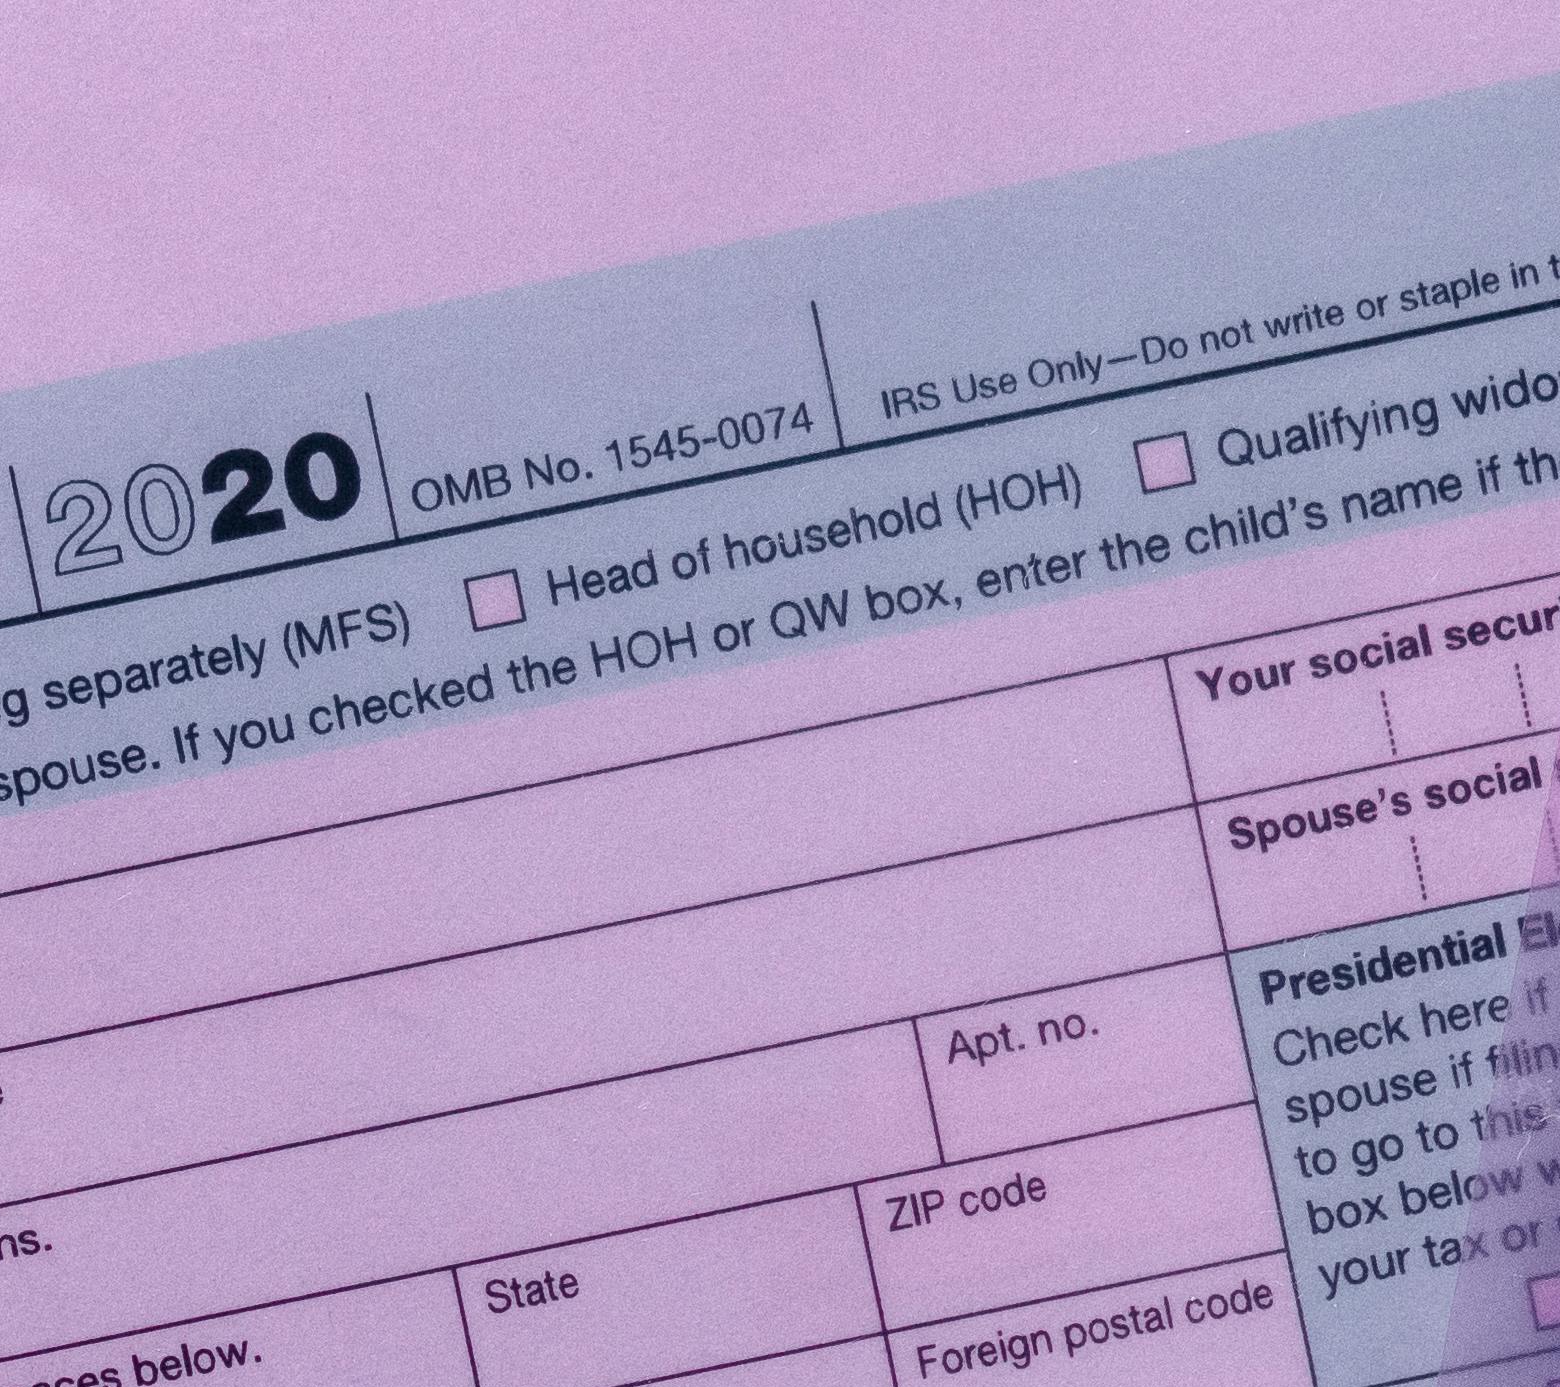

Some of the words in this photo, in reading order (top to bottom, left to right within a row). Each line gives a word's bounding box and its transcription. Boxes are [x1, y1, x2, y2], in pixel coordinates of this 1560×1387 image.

[880, 380, 942, 420] IRS
[951, 372, 1018, 404] Use
[1027, 334, 1189, 388] Only—Do
[1199, 318, 1255, 354] not
[1263, 303, 1345, 339] write
[1355, 294, 1388, 322] or
[1399, 267, 1500, 312] staple
[1509, 262, 1540, 290] in
[410, 463, 512, 512] OMB
[522, 453, 593, 490] No.
[604, 400, 814, 472] 1545-0074
[1216, 396, 1440, 467] Qualifying
[44, 431, 361, 577] 2020
[545, 548, 660, 607] Head
[670, 536, 712, 581] of
[722, 490, 943, 571] household
[954, 460, 1083, 531] (HOH)
[42, 633, 267, 711] separately
[282, 599, 411, 669] (MFS)
[1194, 659, 1296, 702] Your
[1308, 622, 1434, 680] social
[1423, 754, 1543, 811] social
[1258, 921, 1507, 1006] Presidential
[947, 1022, 1026, 1068] Apt.
[1037, 1012, 1100, 1047] no.
[885, 1188, 945, 1233] ZIP
[958, 1171, 1048, 1218] code
[484, 1269, 581, 1315] State
[915, 1329, 1054, 1380] Foreign
[1062, 1295, 1175, 1359] postal
[1184, 1279, 1274, 1325] code
